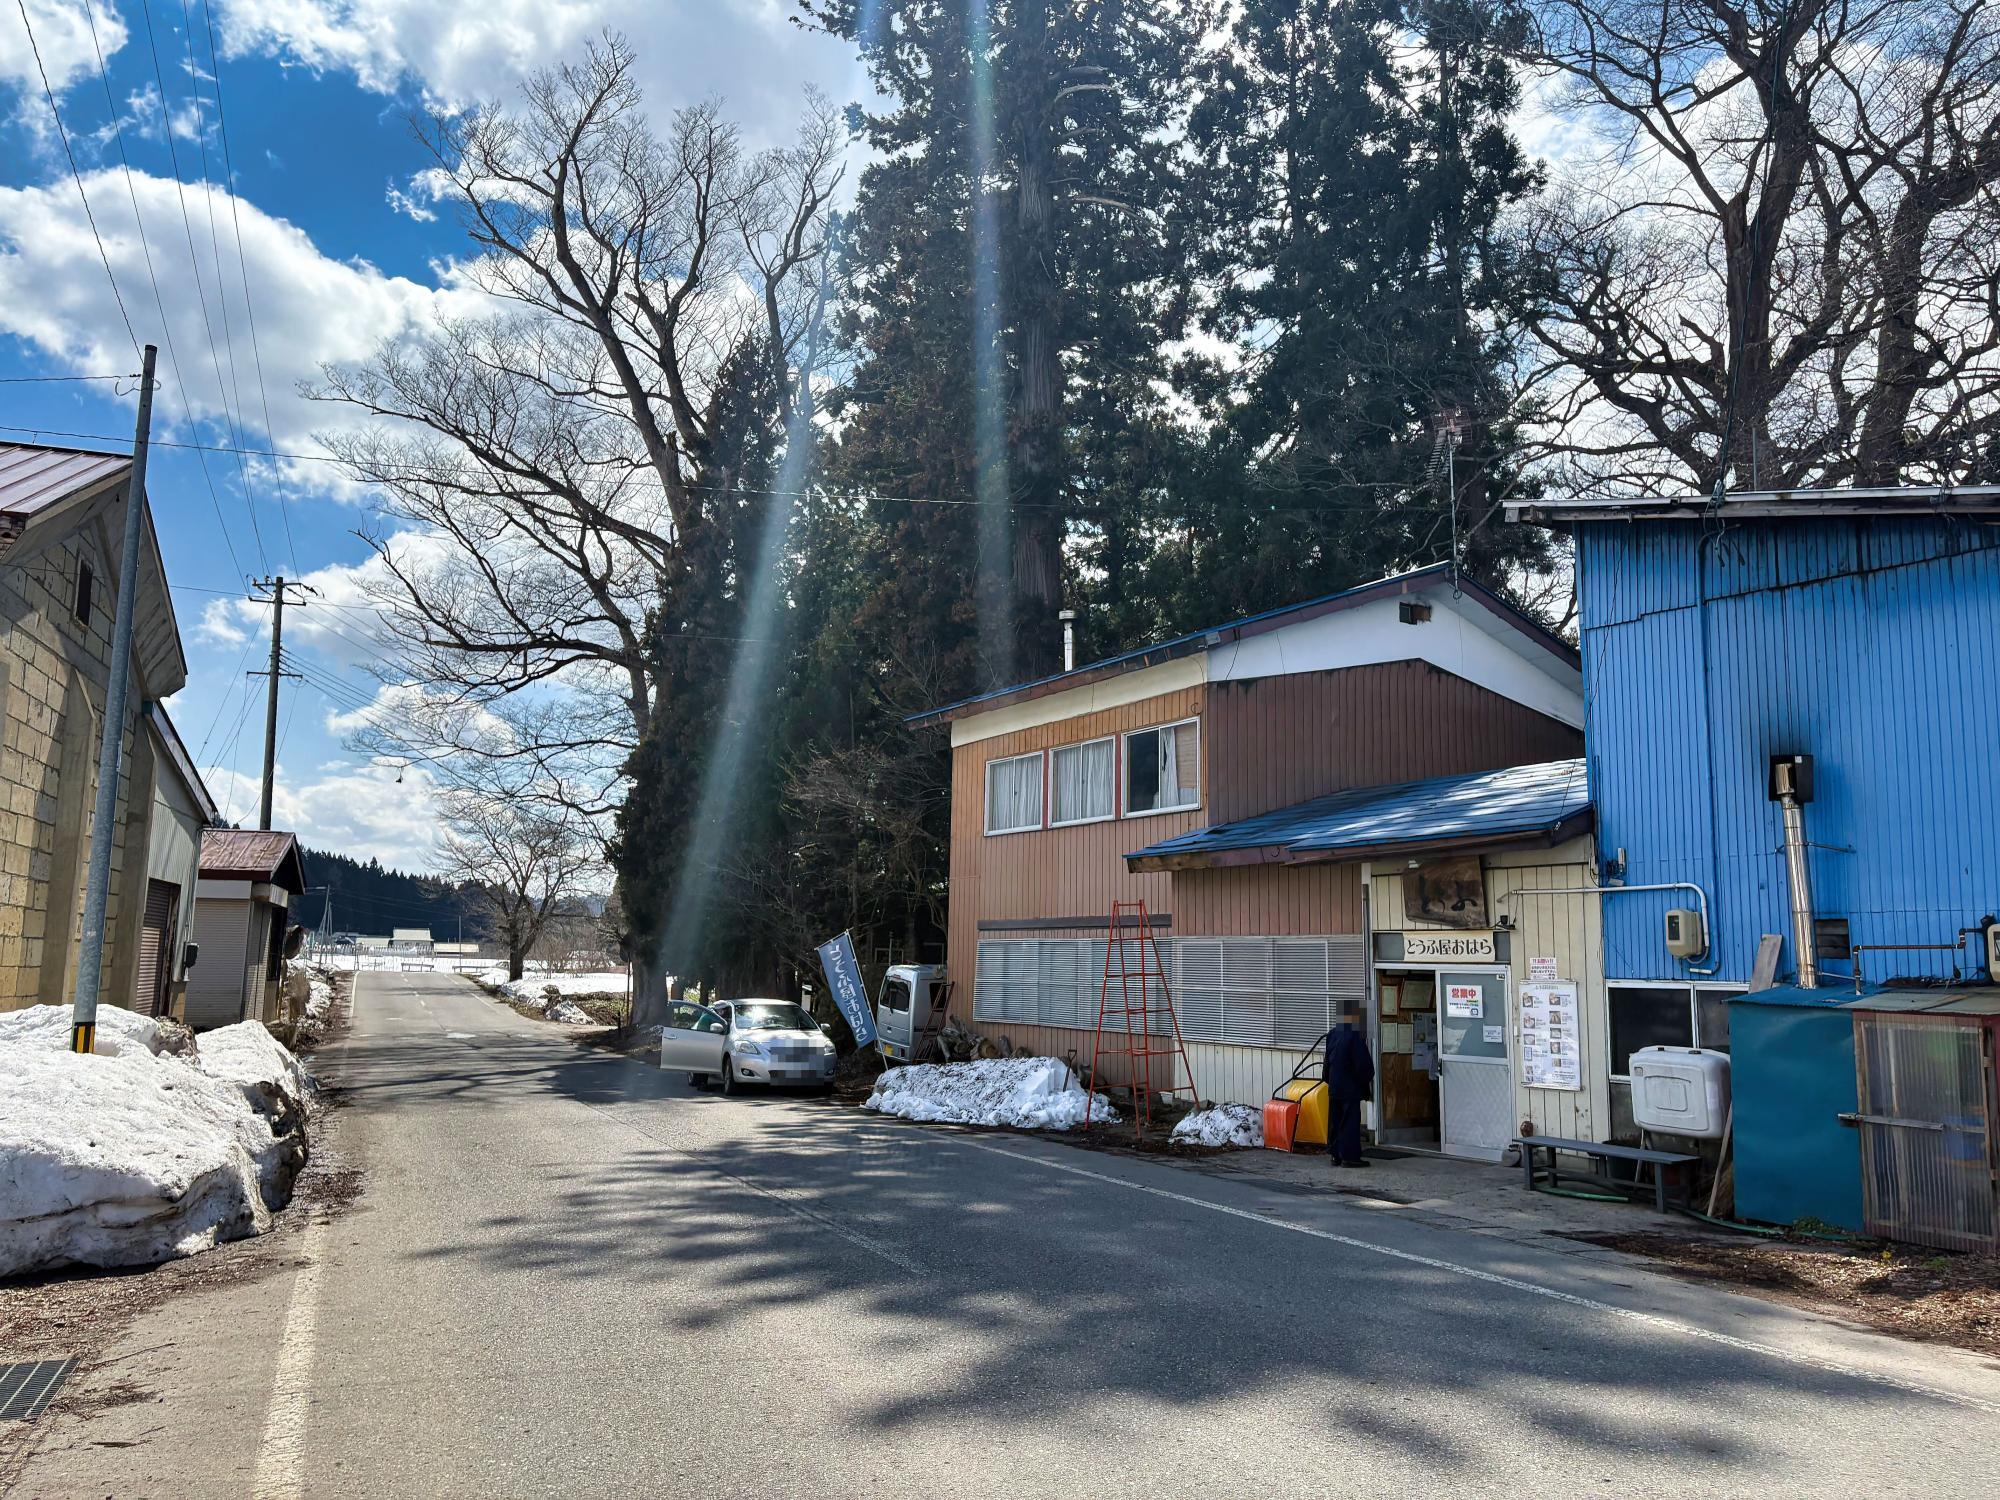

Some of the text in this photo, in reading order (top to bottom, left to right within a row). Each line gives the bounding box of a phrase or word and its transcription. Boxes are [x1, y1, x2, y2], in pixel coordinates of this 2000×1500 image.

[1406, 938, 1492, 955] とうふ屋おはら
[1451, 988, 1477, 999] 営業中
